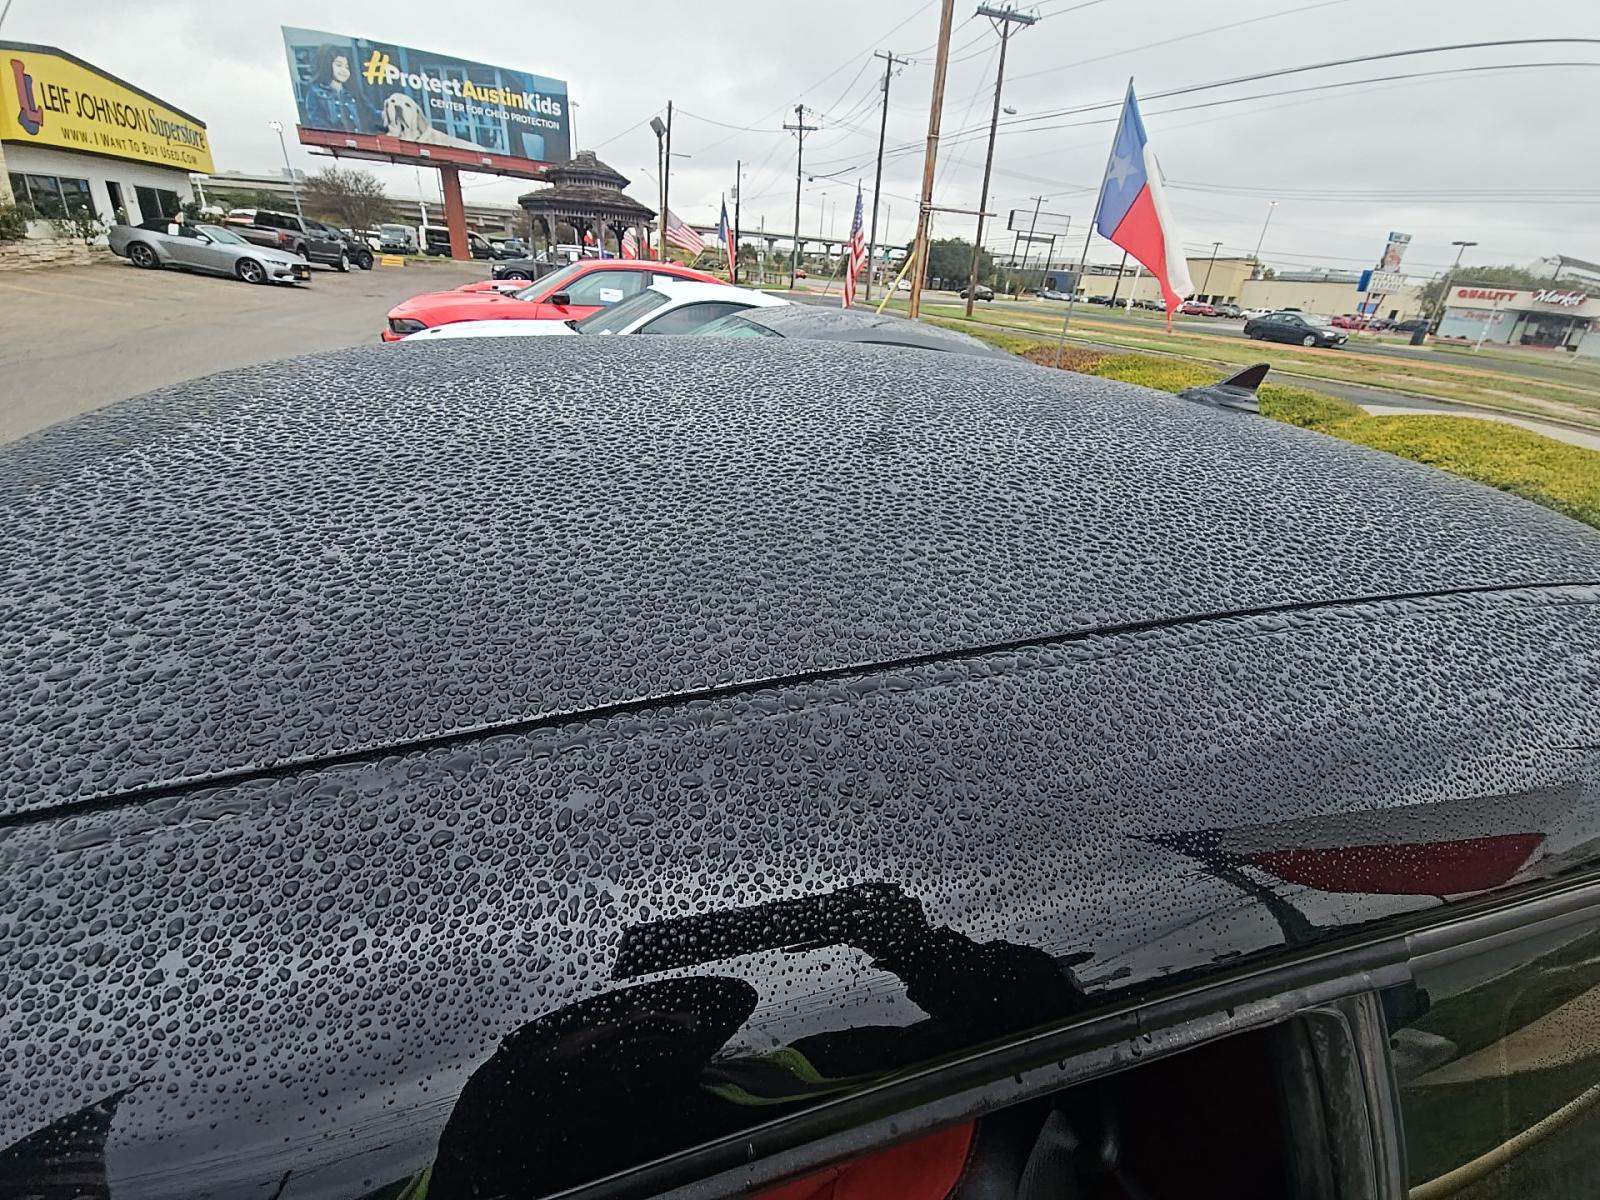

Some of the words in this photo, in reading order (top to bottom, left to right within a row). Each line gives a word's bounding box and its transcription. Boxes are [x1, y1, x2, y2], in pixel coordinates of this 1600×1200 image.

[362, 50, 562, 116] #ProtectAustinKids
[40, 82, 71, 114] LEIF
[75, 91, 149, 133] JOHNSON
[148, 107, 206, 149] Superstore
[430, 98, 464, 112] CENTER
[466, 104, 484, 115] FOR
[484, 107, 510, 120] CHILD
[511, 113, 560, 130] PROTECTION
[99, 133, 127, 151] WANT
[1457, 289, 1518, 301] QUALITY
[1534, 287, 1585, 307] Market
